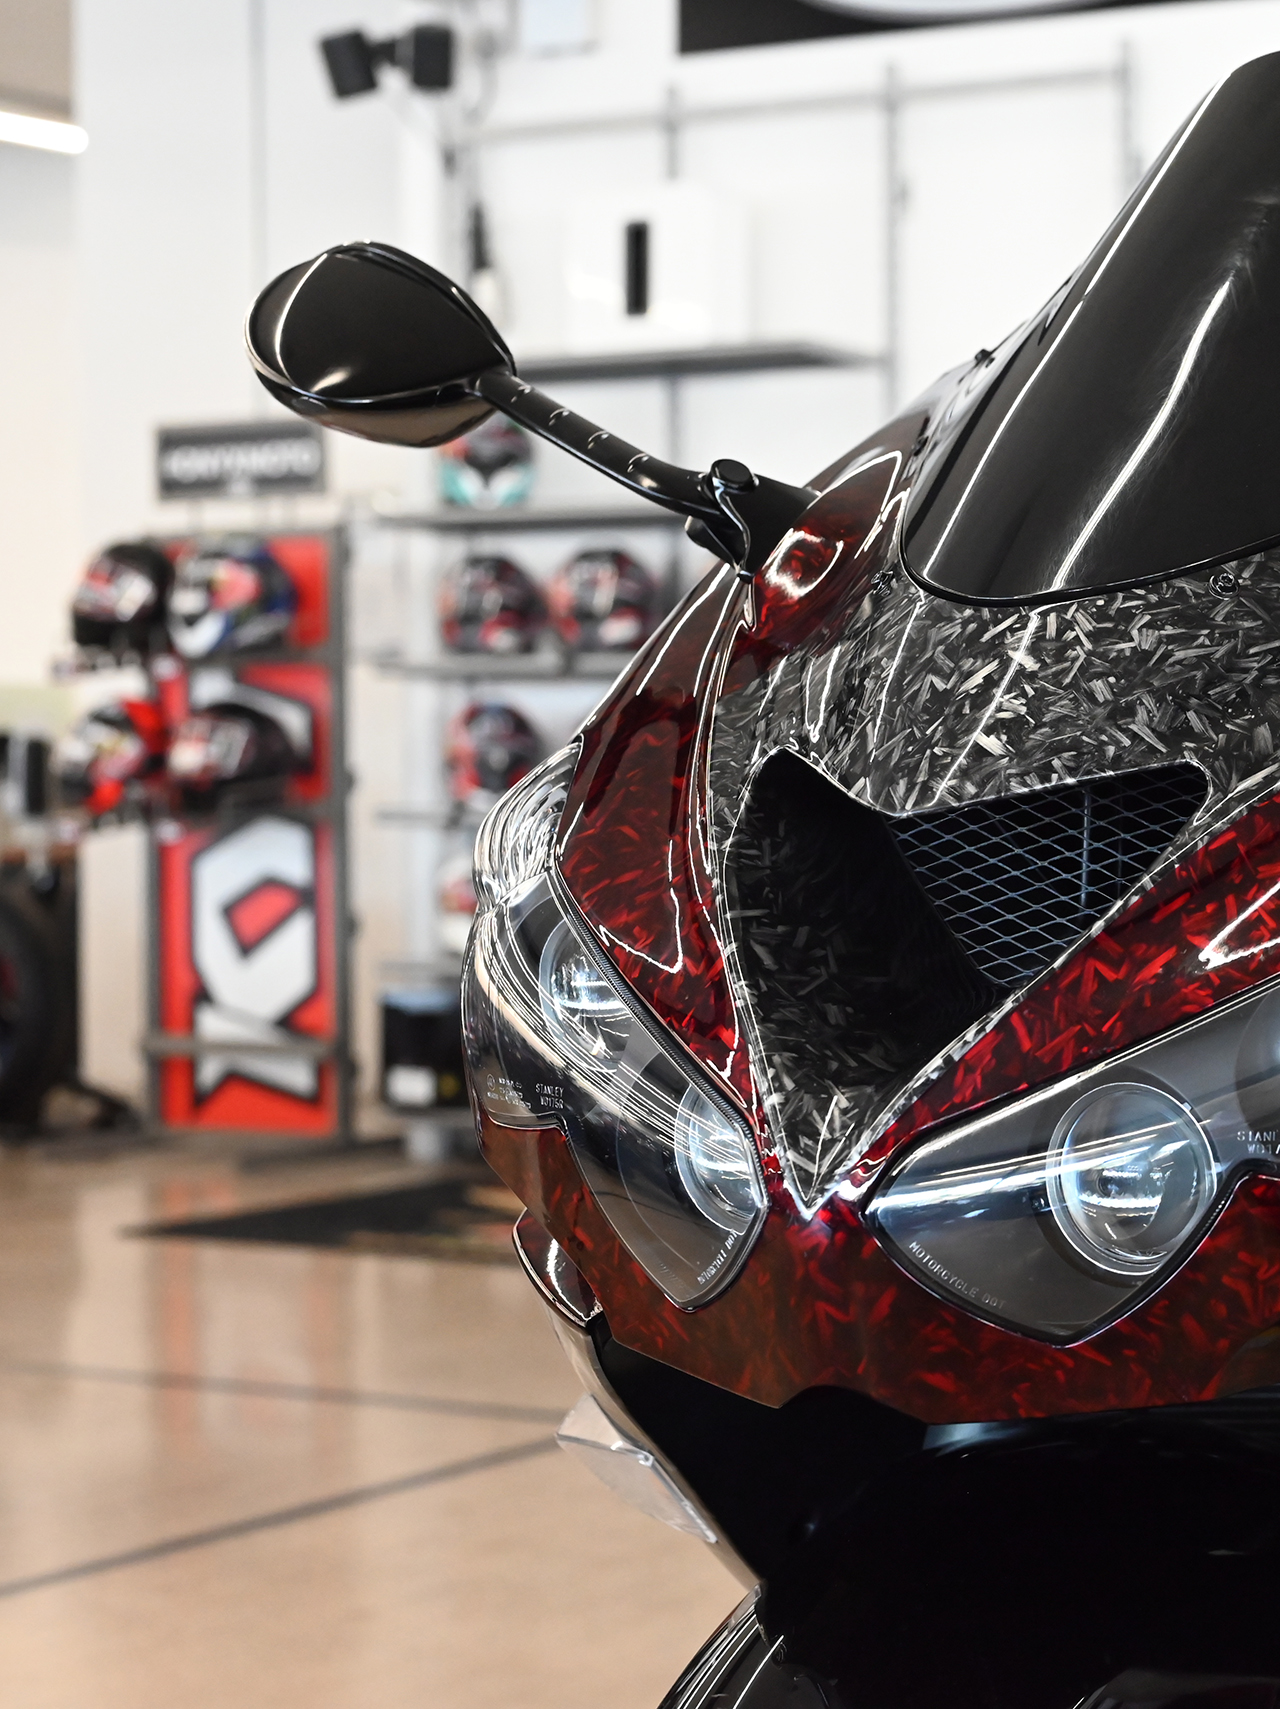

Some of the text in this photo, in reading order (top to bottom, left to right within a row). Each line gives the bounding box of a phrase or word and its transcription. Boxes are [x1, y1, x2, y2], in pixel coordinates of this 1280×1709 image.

[535, 1083, 564, 1098] STANLEY
[909, 1240, 1008, 1309] MOTORCYCLE DOT
